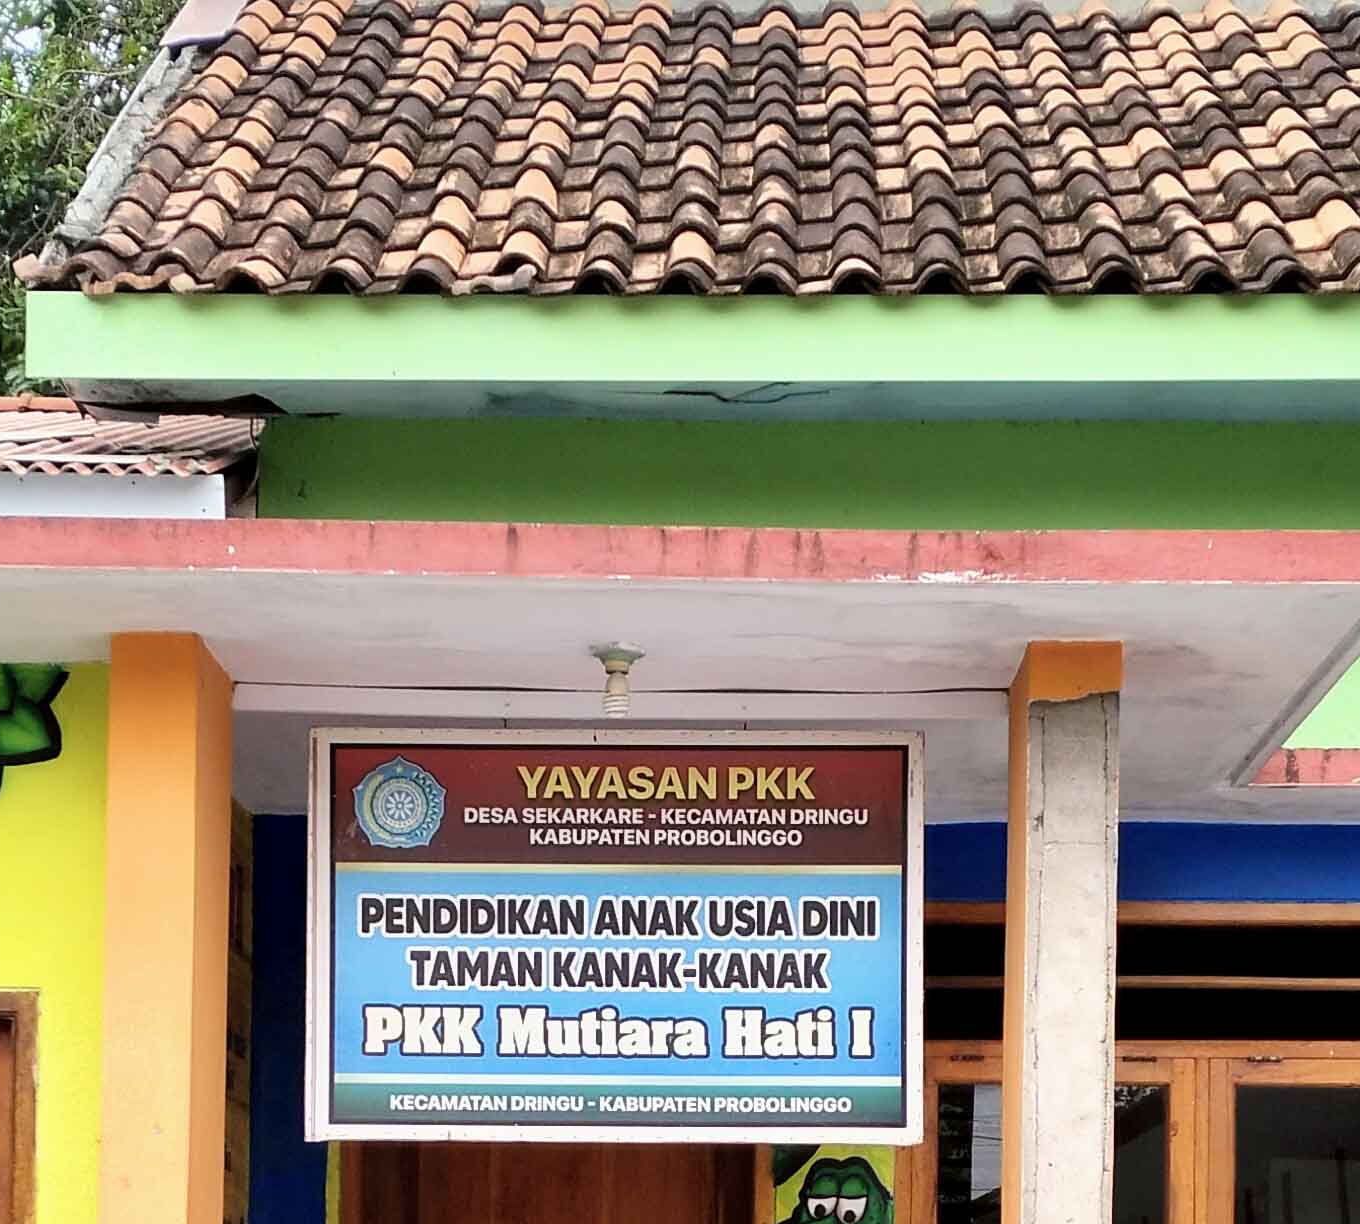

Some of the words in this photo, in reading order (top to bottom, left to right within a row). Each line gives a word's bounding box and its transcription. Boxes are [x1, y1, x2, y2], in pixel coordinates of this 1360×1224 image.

[517, 766, 718, 800] YAYASAN
[727, 766, 816, 800] PKK
[464, 807, 518, 825] DESA
[522, 807, 643, 825] SEKARKARE
[660, 807, 787, 825] KECAMATAN
[790, 808, 868, 826] DRINGU
[529, 829, 650, 846] KABUPATEN
[654, 829, 803, 847] PROBOLINGGO
[360, 897, 585, 936] PENDIDIKAN
[593, 899, 699, 937] ANAK
[708, 899, 793, 938] USIA
[802, 900, 876, 937] DINI
[409, 950, 542, 987] TAMAN
[552, 950, 828, 989] KANAK-KANAK
[363, 1004, 484, 1056] PKK
[496, 1005, 710, 1059] Mutiara
[721, 1006, 837, 1060] Hati
[848, 1006, 875, 1060] I
[389, 1094, 510, 1111] KECAMATAN
[511, 1095, 584, 1112] DRINGU
[599, 1096, 711, 1113] KABUPATEN
[714, 1096, 852, 1113] PROBOLINGGO
